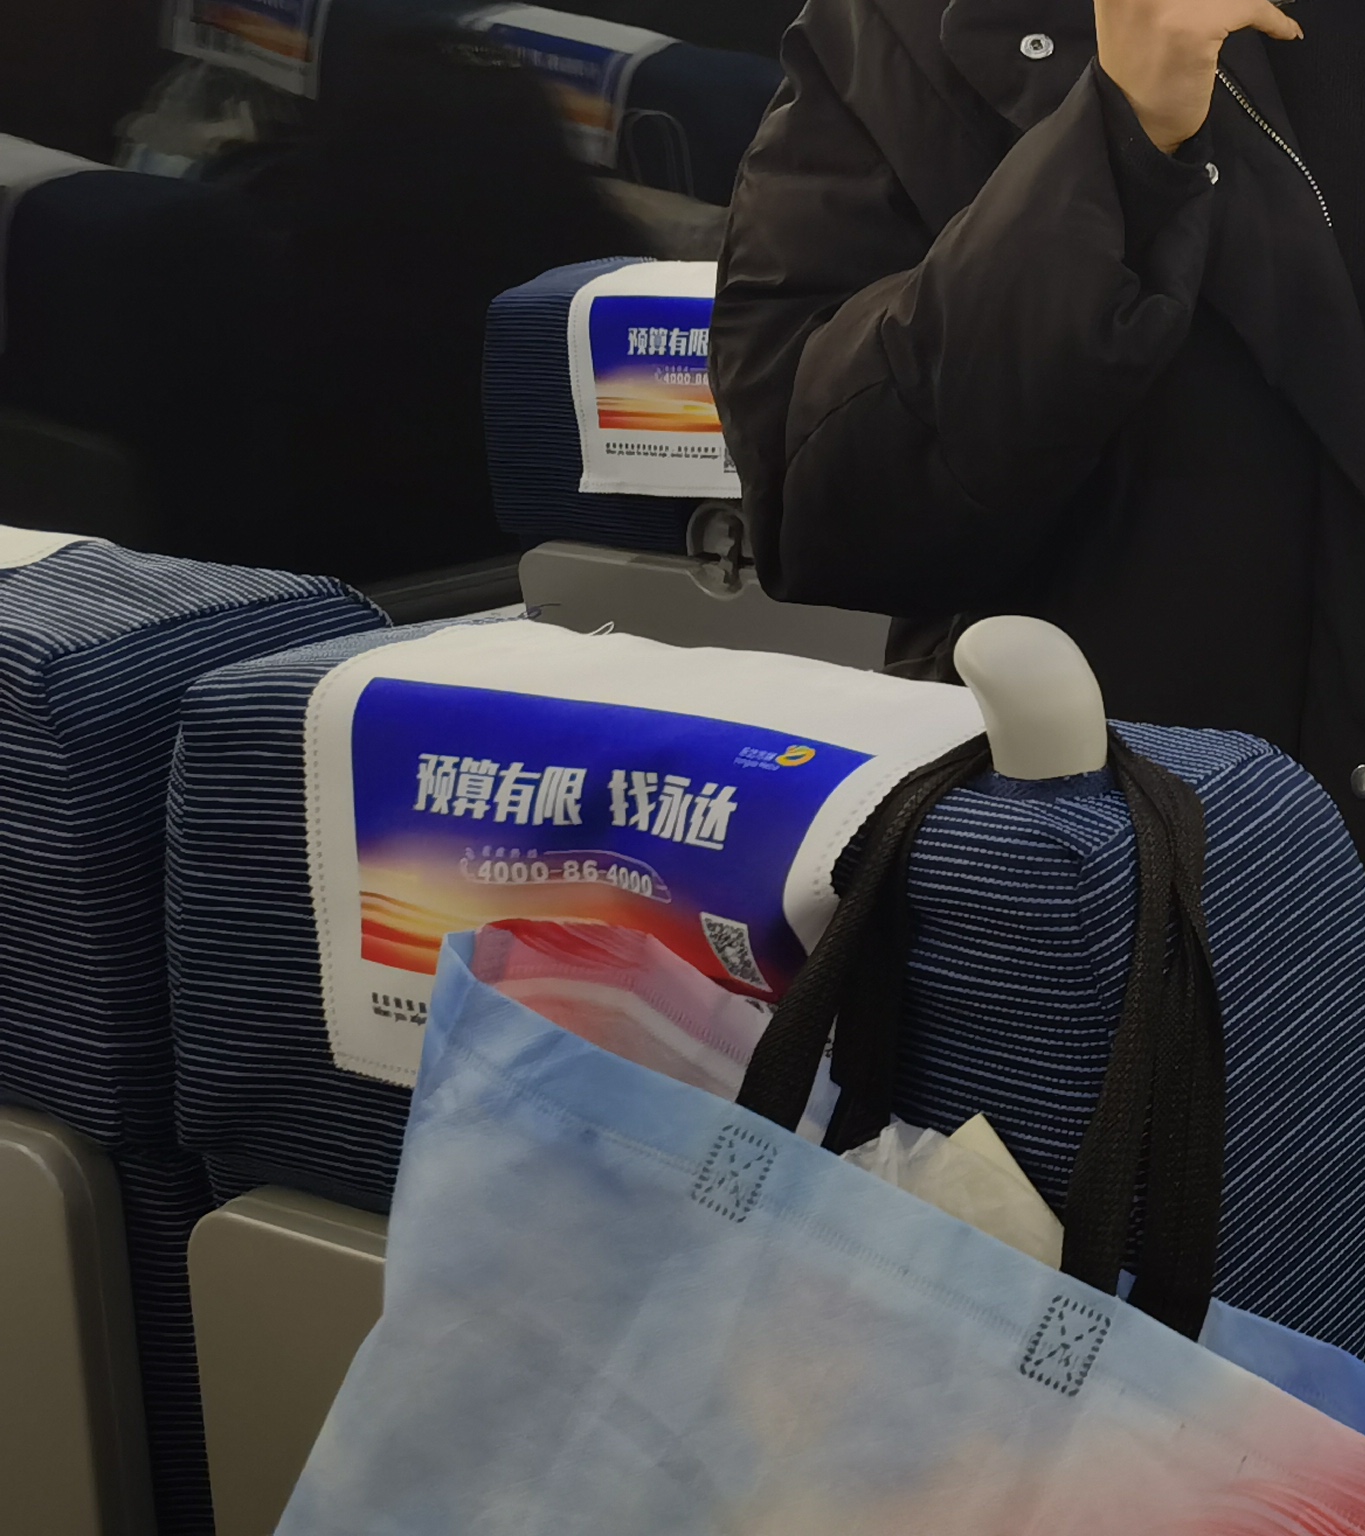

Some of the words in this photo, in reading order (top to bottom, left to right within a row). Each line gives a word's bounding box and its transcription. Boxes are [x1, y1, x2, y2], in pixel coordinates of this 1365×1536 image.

[627, 326, 710, 357] 预算有限
[413, 752, 588, 827] 预算有限
[607, 768, 738, 851] 找永达
[477, 859, 653, 897] 4000-86-4000
